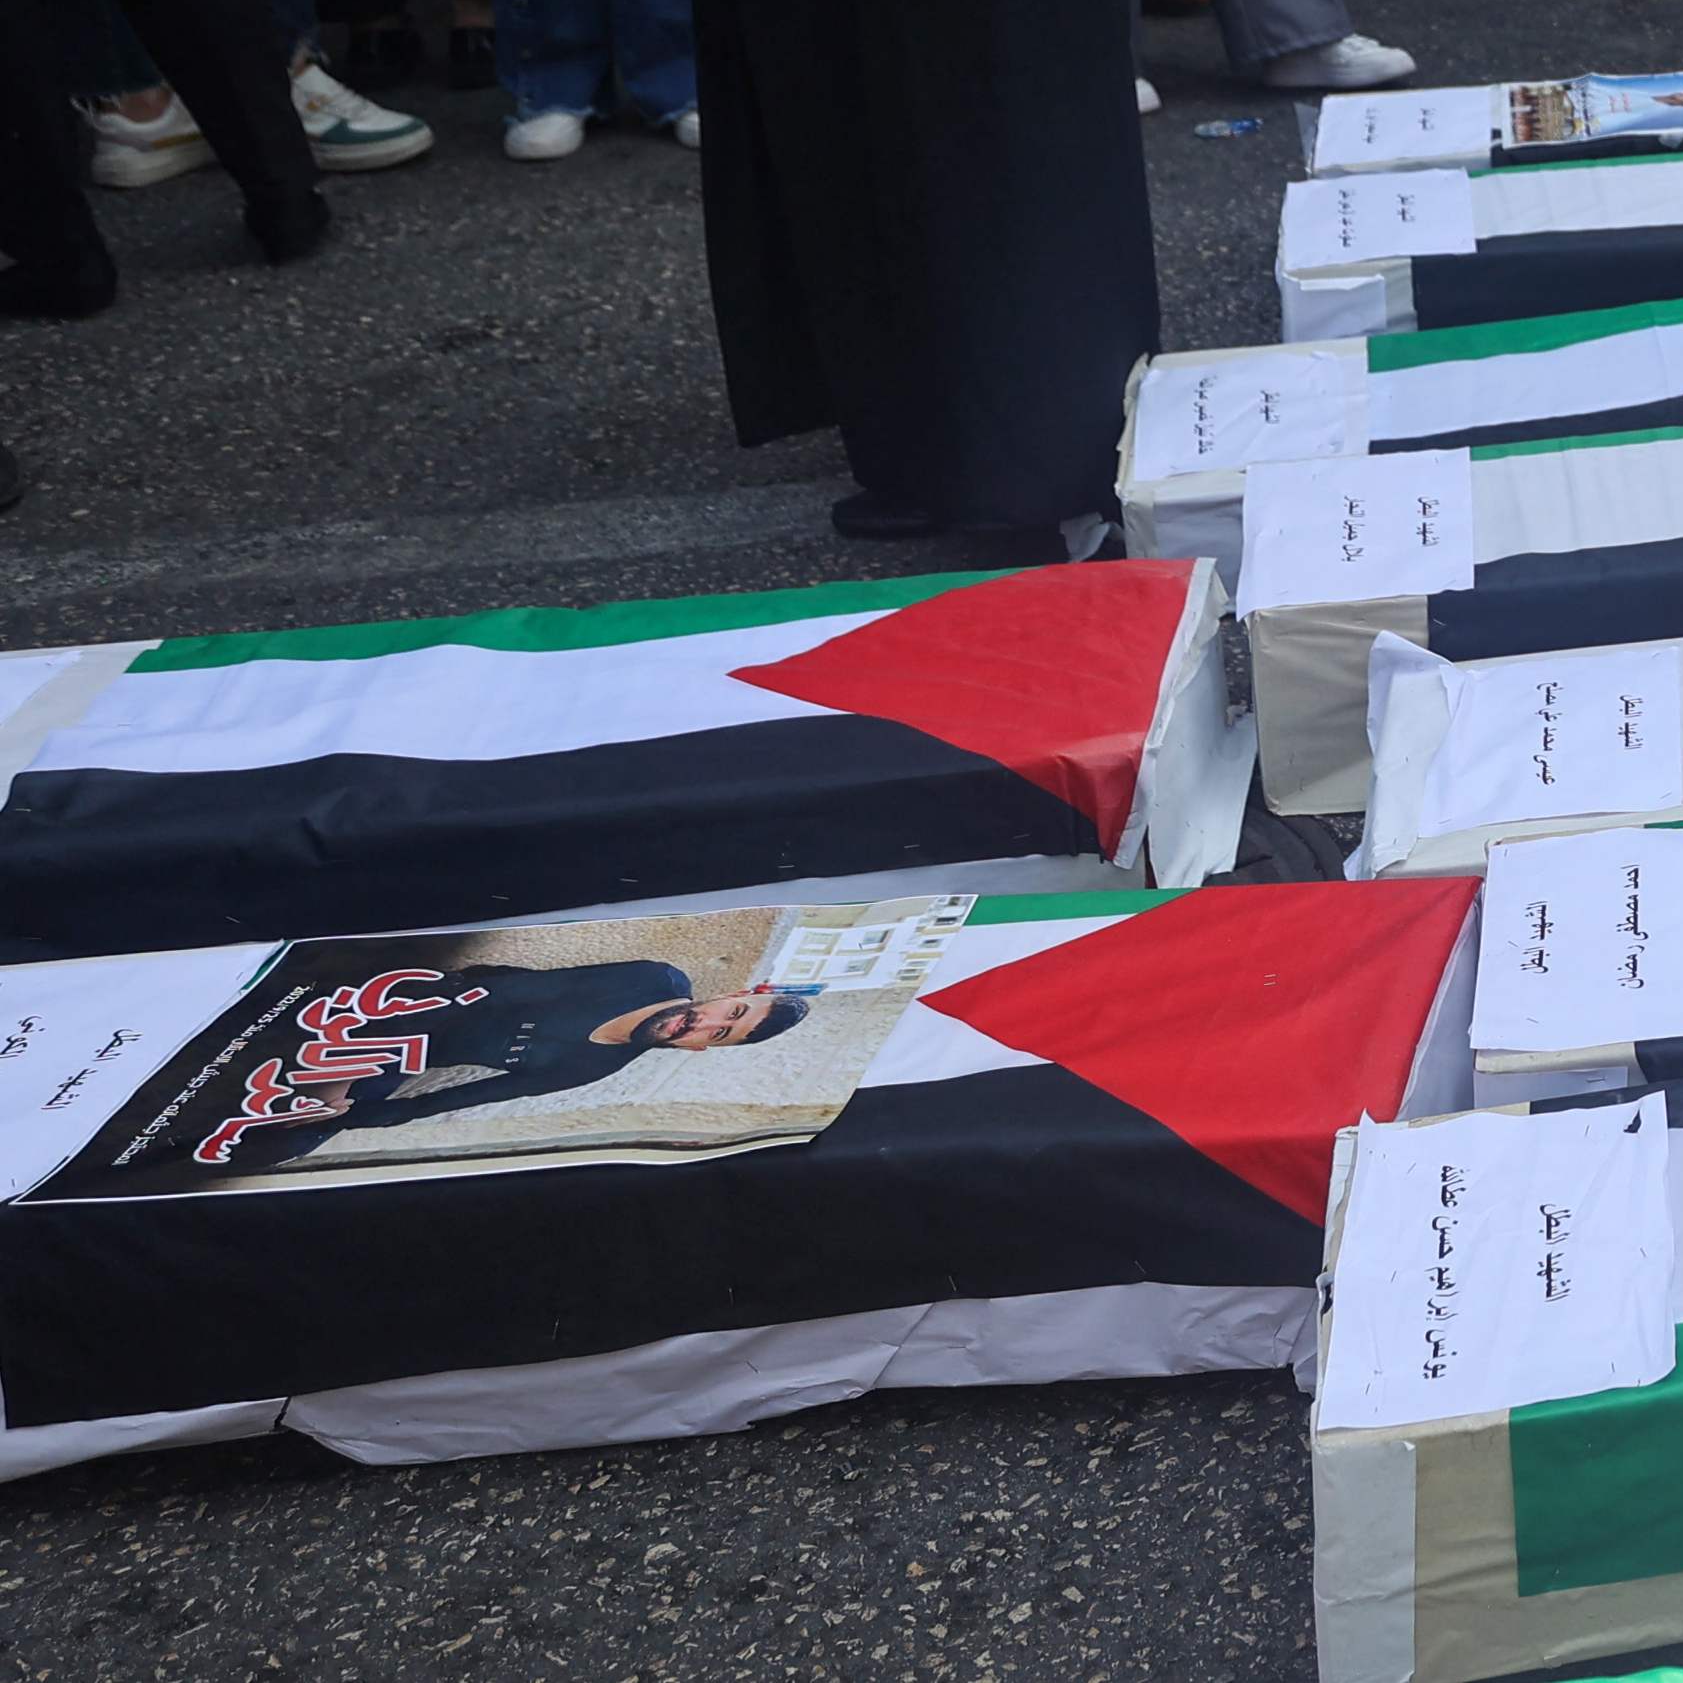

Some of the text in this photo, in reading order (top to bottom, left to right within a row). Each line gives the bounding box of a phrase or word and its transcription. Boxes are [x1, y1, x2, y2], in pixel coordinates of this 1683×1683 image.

[1342, 496, 1364, 562] بلال جميل النجار
[1417, 498, 1438, 545] الشهيد البطل
[1533, 682, 1562, 784] عيسى محمد علي مصلح
[1619, 696, 1643, 749] الشهيد البطل
[1520, 901, 1553, 973] الشهيد البطل
[1617, 865, 1648, 988] احمد مصطفى رمضان
[40, 1024, 143, 1113] الشهيد البطل
[1432, 1217, 1458, 1259] حسن
[1537, 1205, 1571, 1301] الشهيد البطل
[1427, 1267, 1458, 1320] إبراهيم
[1424, 1330, 1457, 1379] يونس
